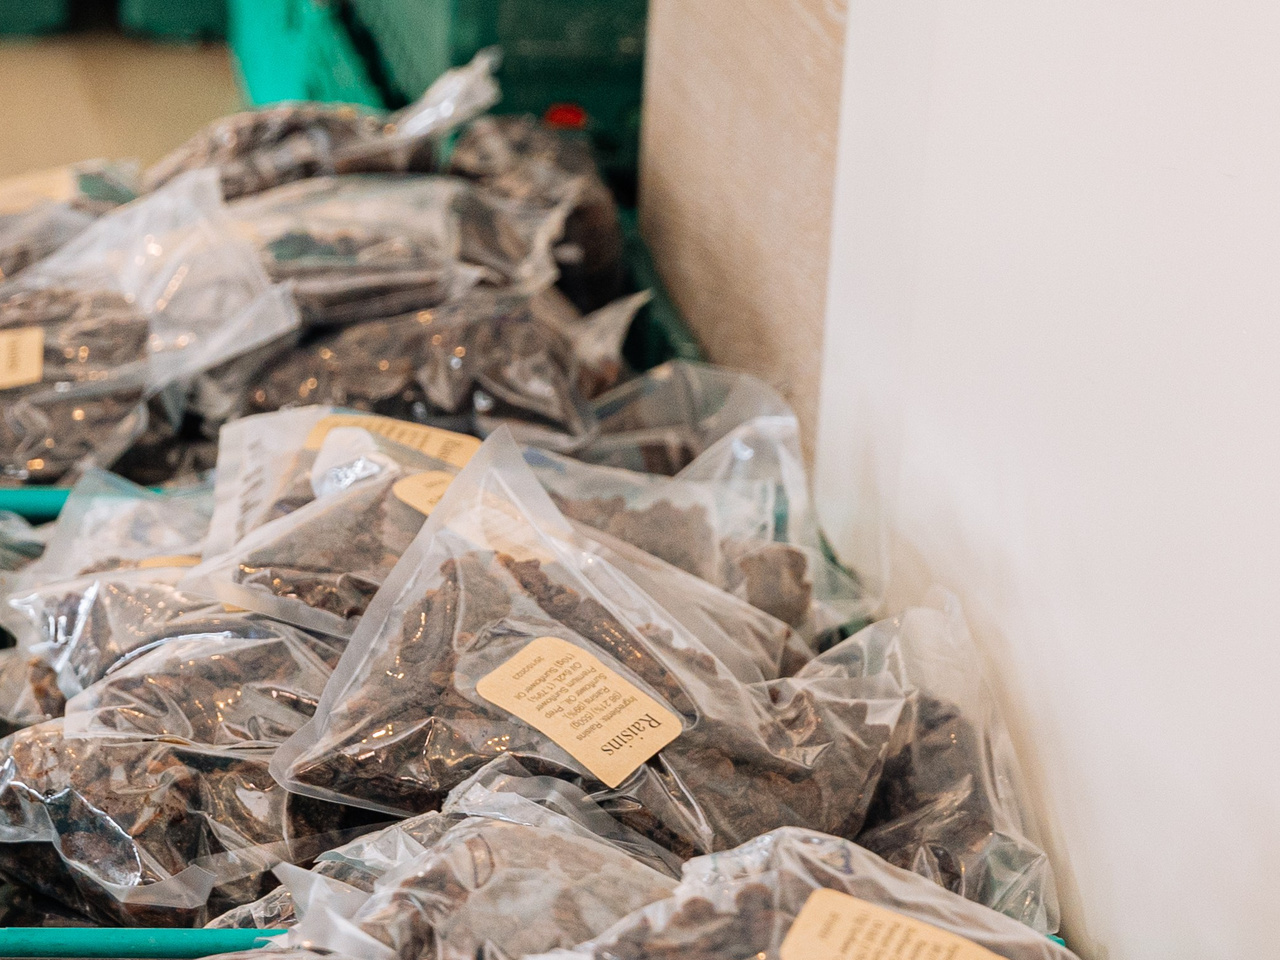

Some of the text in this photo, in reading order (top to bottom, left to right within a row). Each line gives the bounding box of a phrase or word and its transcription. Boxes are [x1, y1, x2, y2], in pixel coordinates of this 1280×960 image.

[569, 660, 582, 671] Oil
[523, 666, 558, 693] Sunflower
[534, 665, 596, 711] Premium Sunflower
[574, 672, 607, 696] Sunflower
[512, 691, 526, 701] Oil
[583, 685, 610, 705] Raisins
[542, 704, 563, 719] Prep
[568, 710, 594, 730] (550g)
[575, 721, 602, 741] Raisins
[600, 713, 662, 756] Raisins
